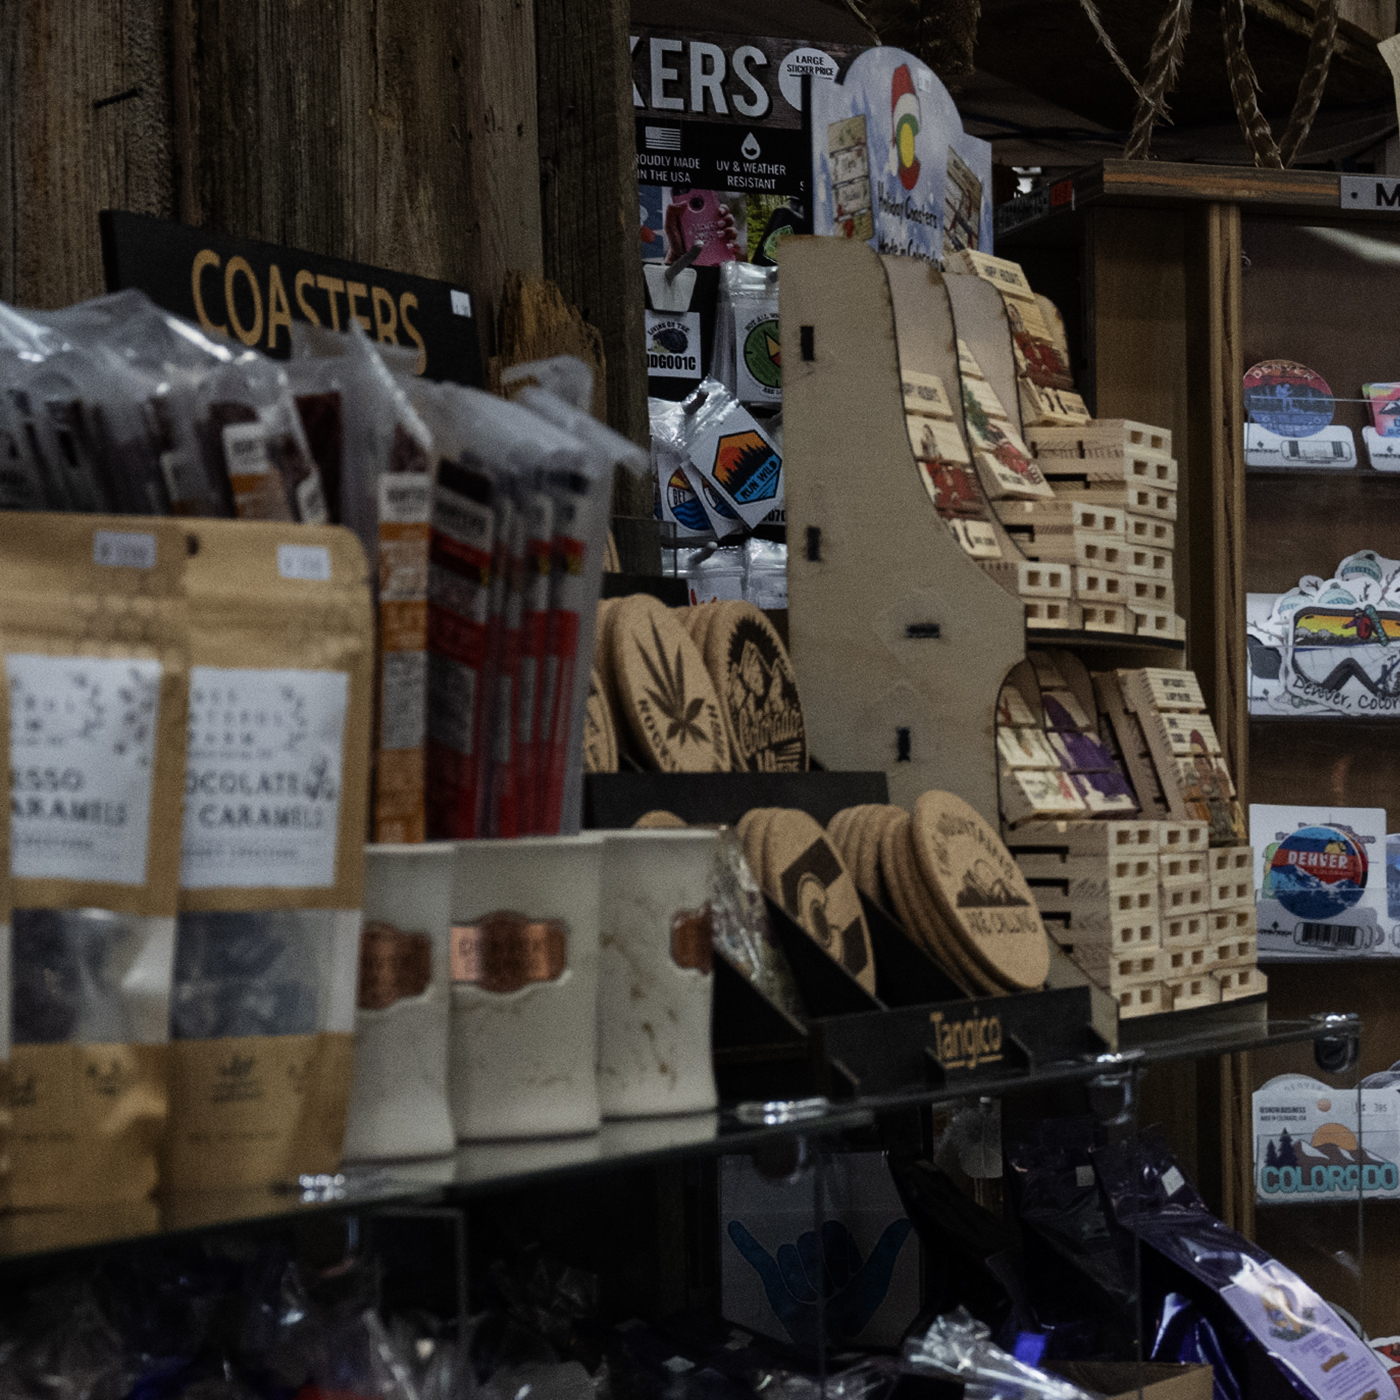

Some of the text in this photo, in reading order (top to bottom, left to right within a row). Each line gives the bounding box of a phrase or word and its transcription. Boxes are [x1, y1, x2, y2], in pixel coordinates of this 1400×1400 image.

[786, 63, 834, 77] STICKER PRICE
[796, 55, 825, 66] LARGE
[673, 157, 701, 169] MADE
[716, 161, 787, 176] UV & WEATHER
[650, 172, 668, 182] THE
[670, 173, 692, 184] USA
[727, 176, 777, 190] RESISTANT
[190, 249, 428, 377] COASTERS
[1251, 362, 1316, 382] DENVER
[740, 459, 778, 500] RUN WILD
[1292, 674, 1351, 710] Denver,
[1287, 849, 1349, 869] DENVER
[929, 1004, 1003, 1069] Tangico
[1261, 1164, 1400, 1194] COLORADO
